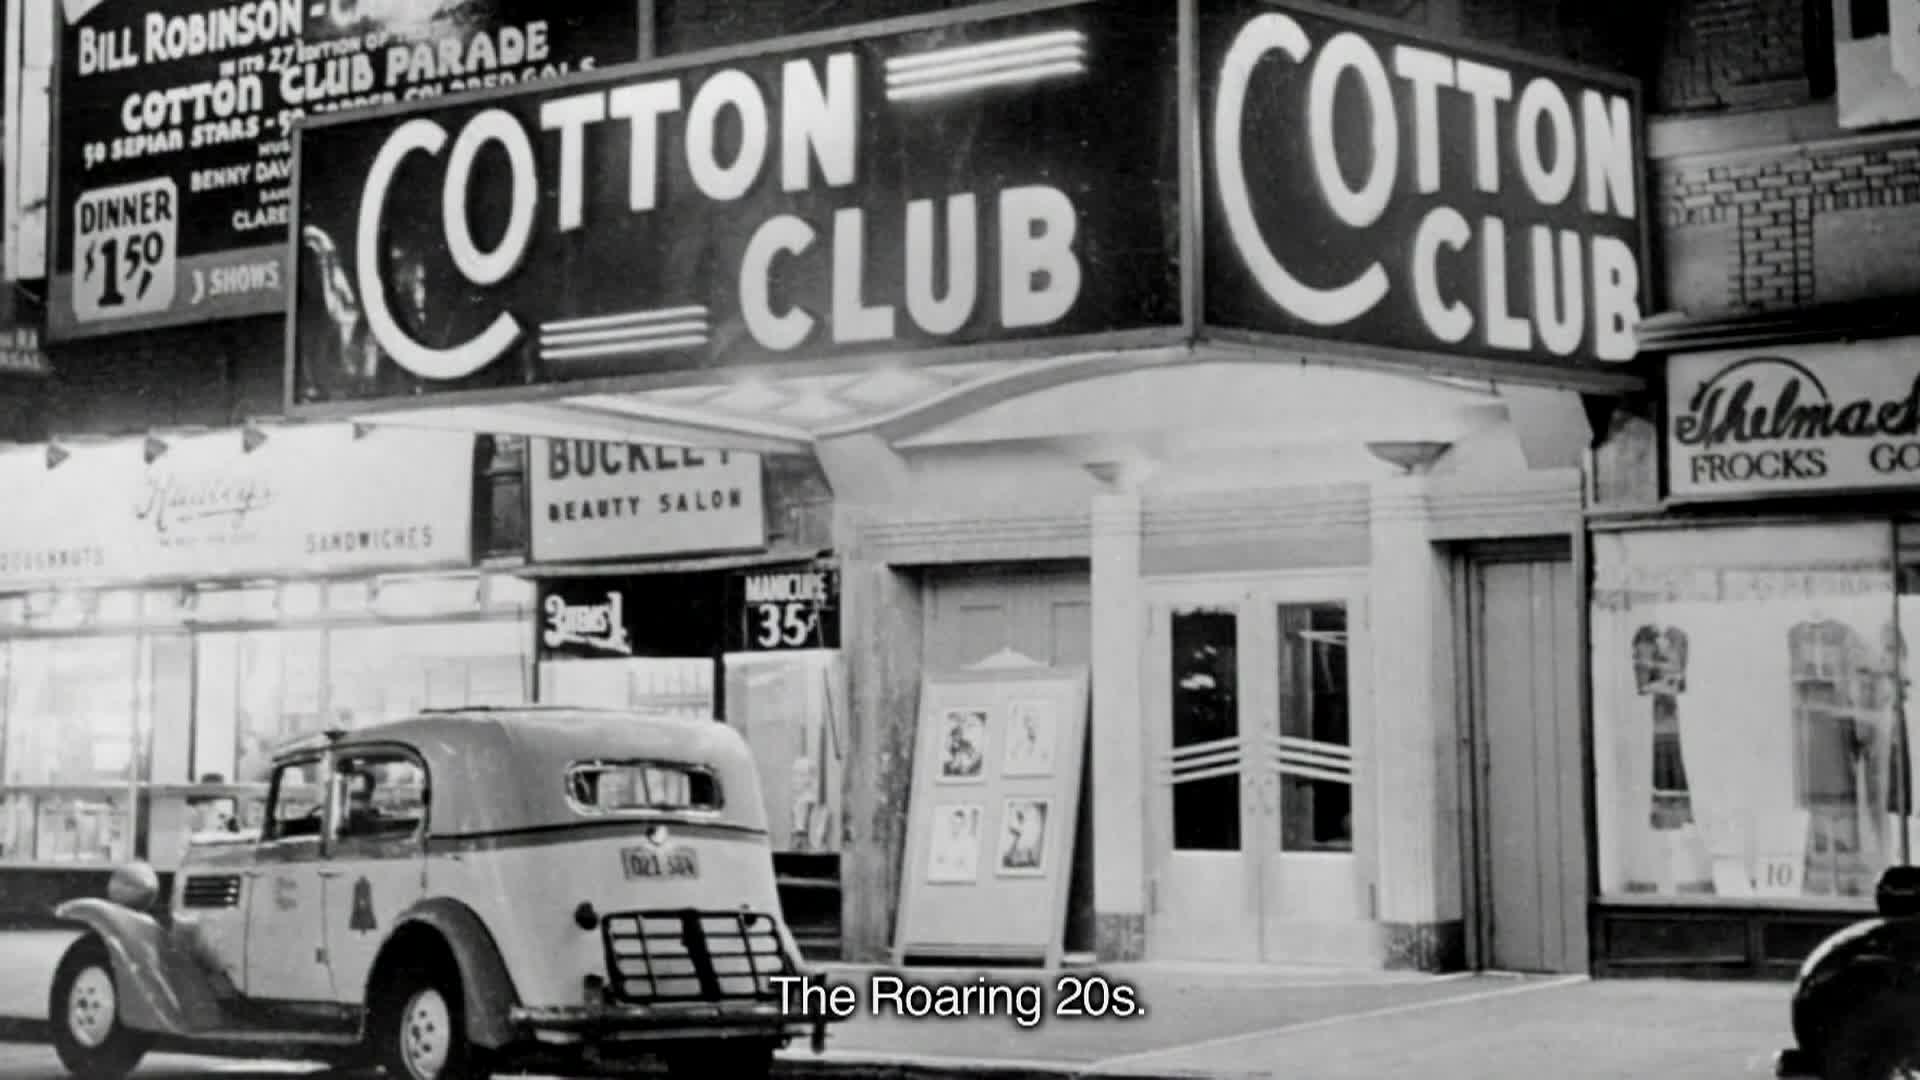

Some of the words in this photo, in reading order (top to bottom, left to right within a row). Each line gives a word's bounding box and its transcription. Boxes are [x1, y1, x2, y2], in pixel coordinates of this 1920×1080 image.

[78, 27, 138, 76] BILL
[144, 0, 303, 64] ROBINSON
[121, 75, 264, 133] COTTON
[279, 53, 375, 104] CLUB
[385, 20, 549, 87] PARADE
[111, 129, 184, 161] SEPIAN
[190, 115, 260, 148] STARS
[190, 165, 250, 192] BENNY
[1215, 12, 1637, 326] COTTON
[80, 189, 172, 235] DINNER
[357, 52, 860, 381] COTTON
[208, 260, 281, 296] SHOWS
[739, 184, 1084, 353] CLUB
[1413, 206, 1641, 363] CLUB
[1691, 449, 1828, 484] FROCKS
[548, 496, 640, 522] BEAUTY
[659, 488, 742, 513] SALON
[305, 526, 434, 553] SANDWICHES
